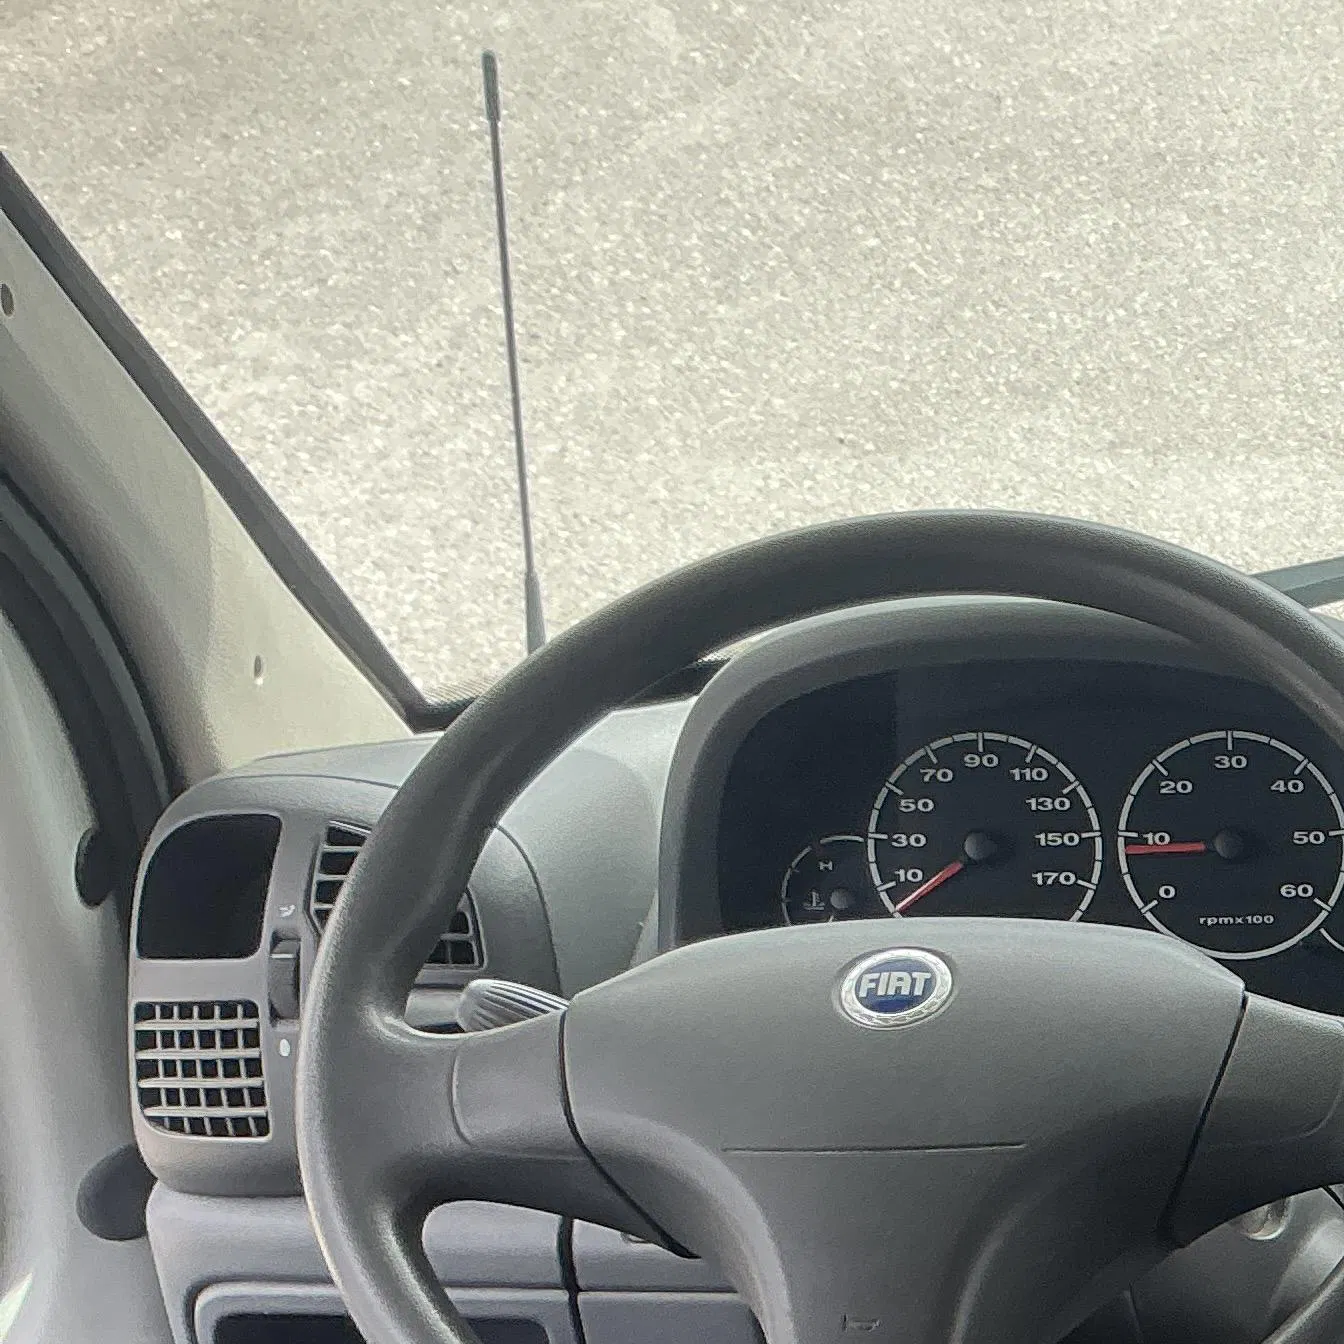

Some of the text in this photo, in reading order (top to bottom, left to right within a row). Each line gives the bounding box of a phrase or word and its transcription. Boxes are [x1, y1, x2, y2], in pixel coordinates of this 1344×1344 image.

[963, 753, 999, 768] 90
[1213, 755, 1248, 769] 30
[920, 768, 954, 782] 70
[1009, 767, 1049, 781] 110
[1159, 780, 1193, 794] 20
[1270, 779, 1305, 793] 40
[899, 798, 935, 812] 50
[1025, 797, 1071, 811] 130
[891, 833, 927, 847] 30
[1034, 832, 1080, 846] 150
[1142, 832, 1171, 845] 10
[1292, 831, 1326, 845] 50
[894, 868, 924, 882] 10
[1031, 871, 1077, 885] 170
[1158, 885, 1176, 899] 0
[1279, 884, 1314, 898] 60
[1199, 914, 1275, 927] rpmx100
[858, 971, 932, 998] FIAT
